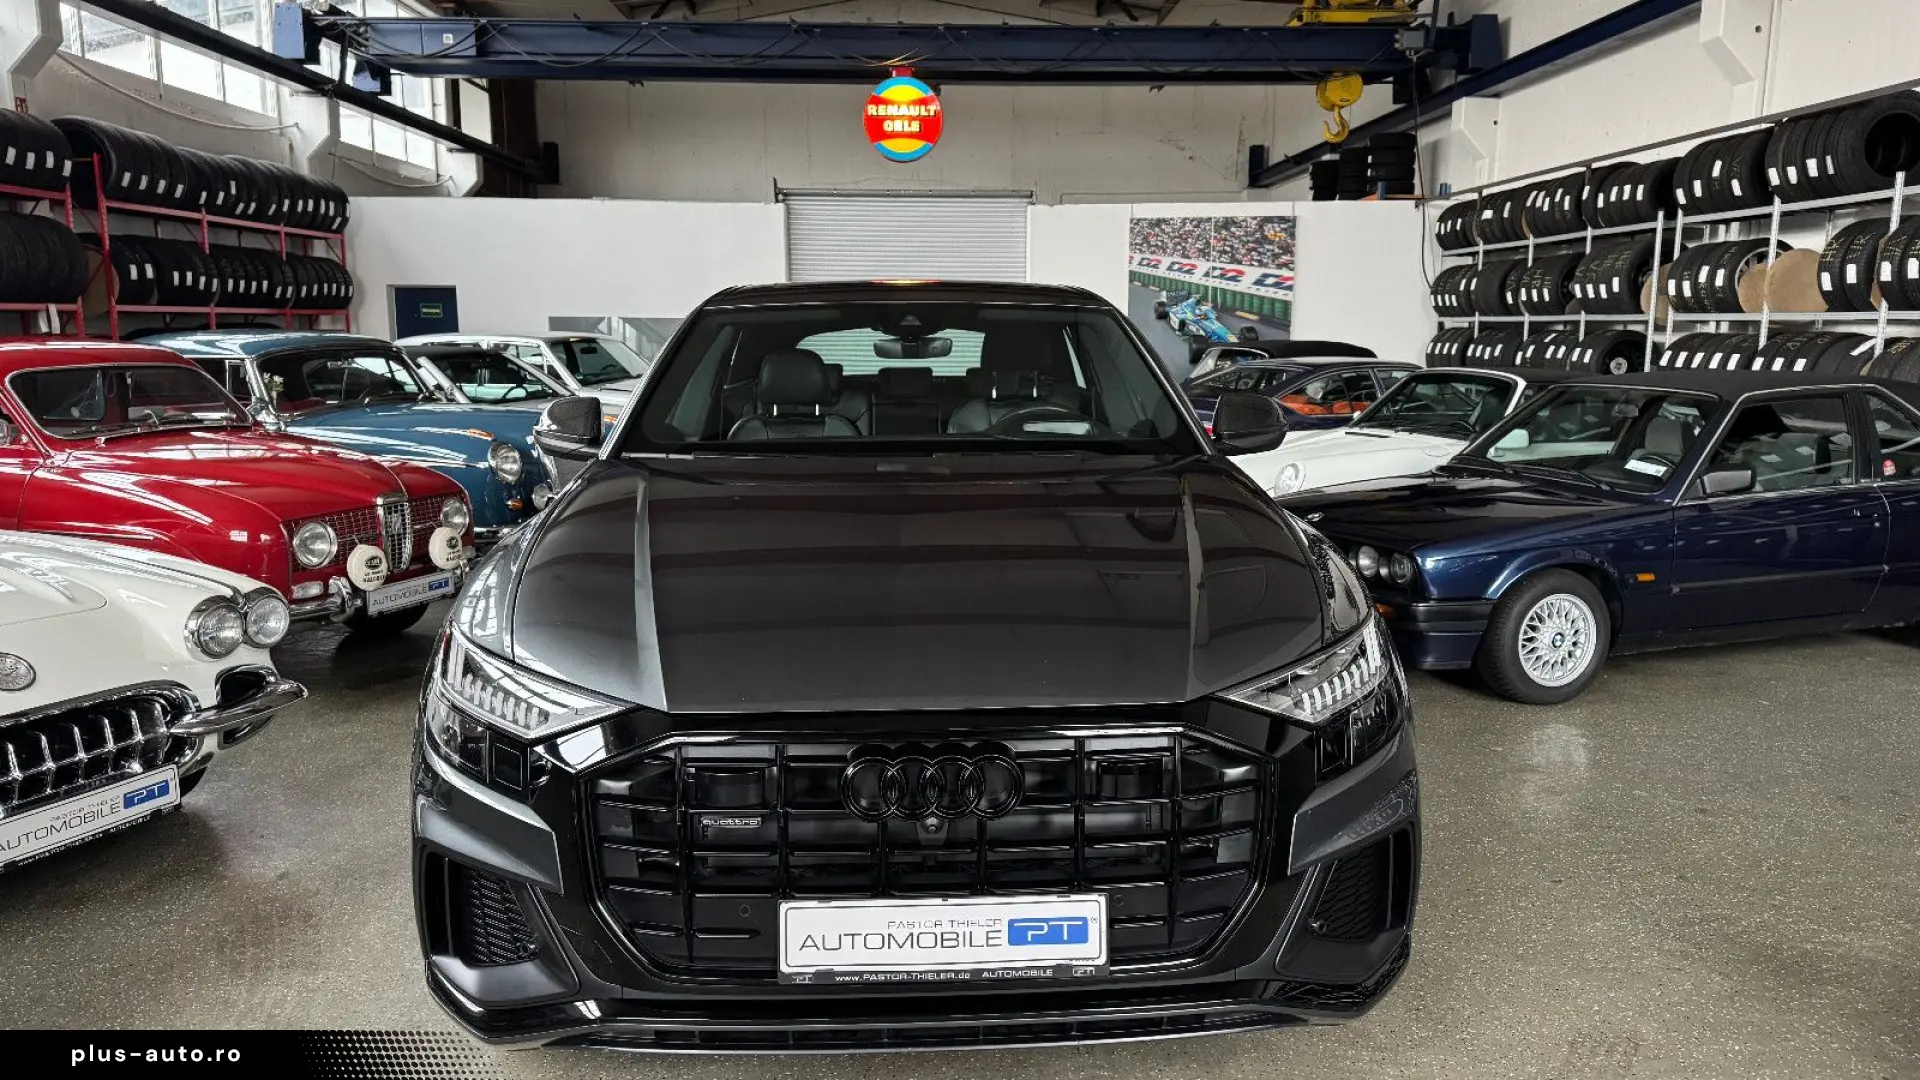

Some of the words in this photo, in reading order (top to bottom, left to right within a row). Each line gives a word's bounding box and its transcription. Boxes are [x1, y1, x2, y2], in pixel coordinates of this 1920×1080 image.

[867, 104, 937, 116] RENAULT
[125, 782, 168, 804] PT
[887, 920, 943, 930] PASTOR
[949, 918, 1003, 929] THIELER
[798, 930, 1003, 951] AUTOMOBILE
[1012, 920, 1084, 942] PT
[982, 969, 1054, 979] AUTOMOBILE
